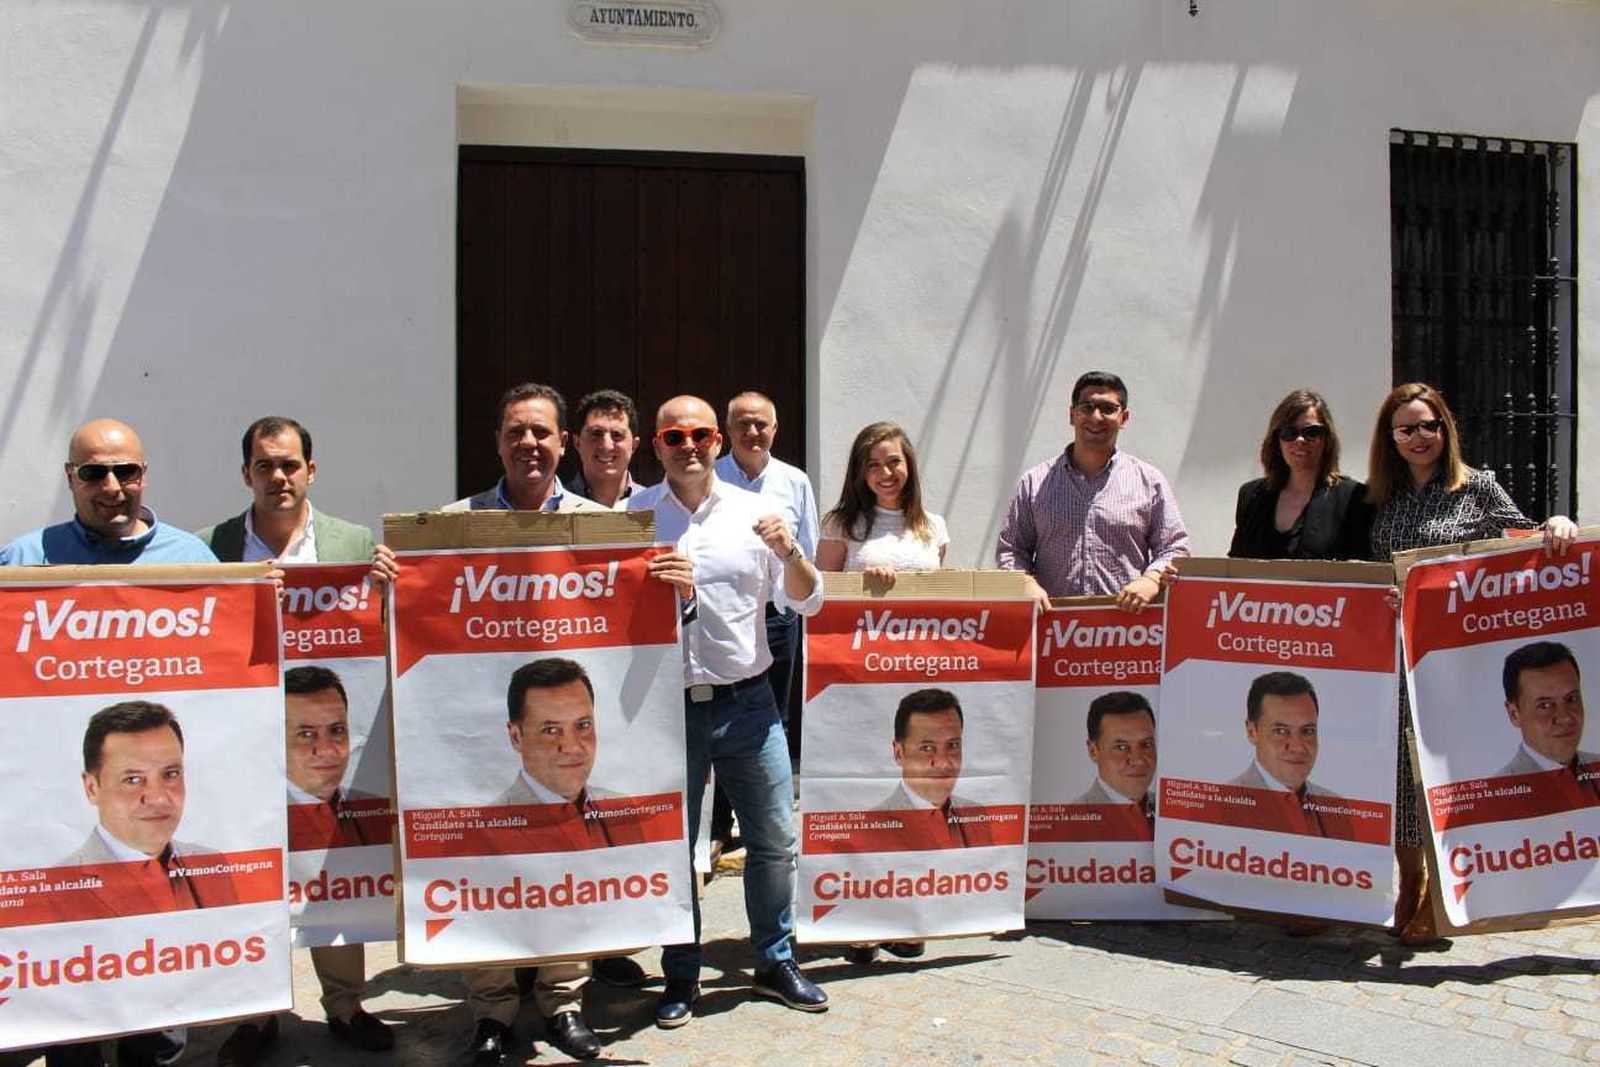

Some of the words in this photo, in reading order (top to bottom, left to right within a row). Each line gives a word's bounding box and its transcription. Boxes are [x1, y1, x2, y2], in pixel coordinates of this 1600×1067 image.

[589, 8, 699, 29] AYUNTAMIENTO.
[449, 560, 618, 614] ¡Vamos!
[1447, 551, 1593, 614] ¡Vamos!
[16, 597, 217, 653] ¡Vamos!
[1205, 591, 1347, 629] ¡Vamos!
[1462, 601, 1588, 634] Cortegana
[465, 615, 610, 643] Cortegana
[851, 609, 990, 651] ¡Vamos!
[1217, 632, 1336, 660] Cortegana
[35, 656, 204, 685] Cortegana
[864, 652, 979, 676] Cortegana
[1054, 658, 1163, 680] Cortegana
[583, 803, 674, 820] #VamosCortegana
[168, 860, 273, 878] #VamosCortegana
[1168, 837, 1374, 891] Ciudadanos
[1449, 830, 1600, 878] Ciudada
[423, 872, 670, 915] Ciudadanos
[813, 868, 1010, 901] Ciudadanos
